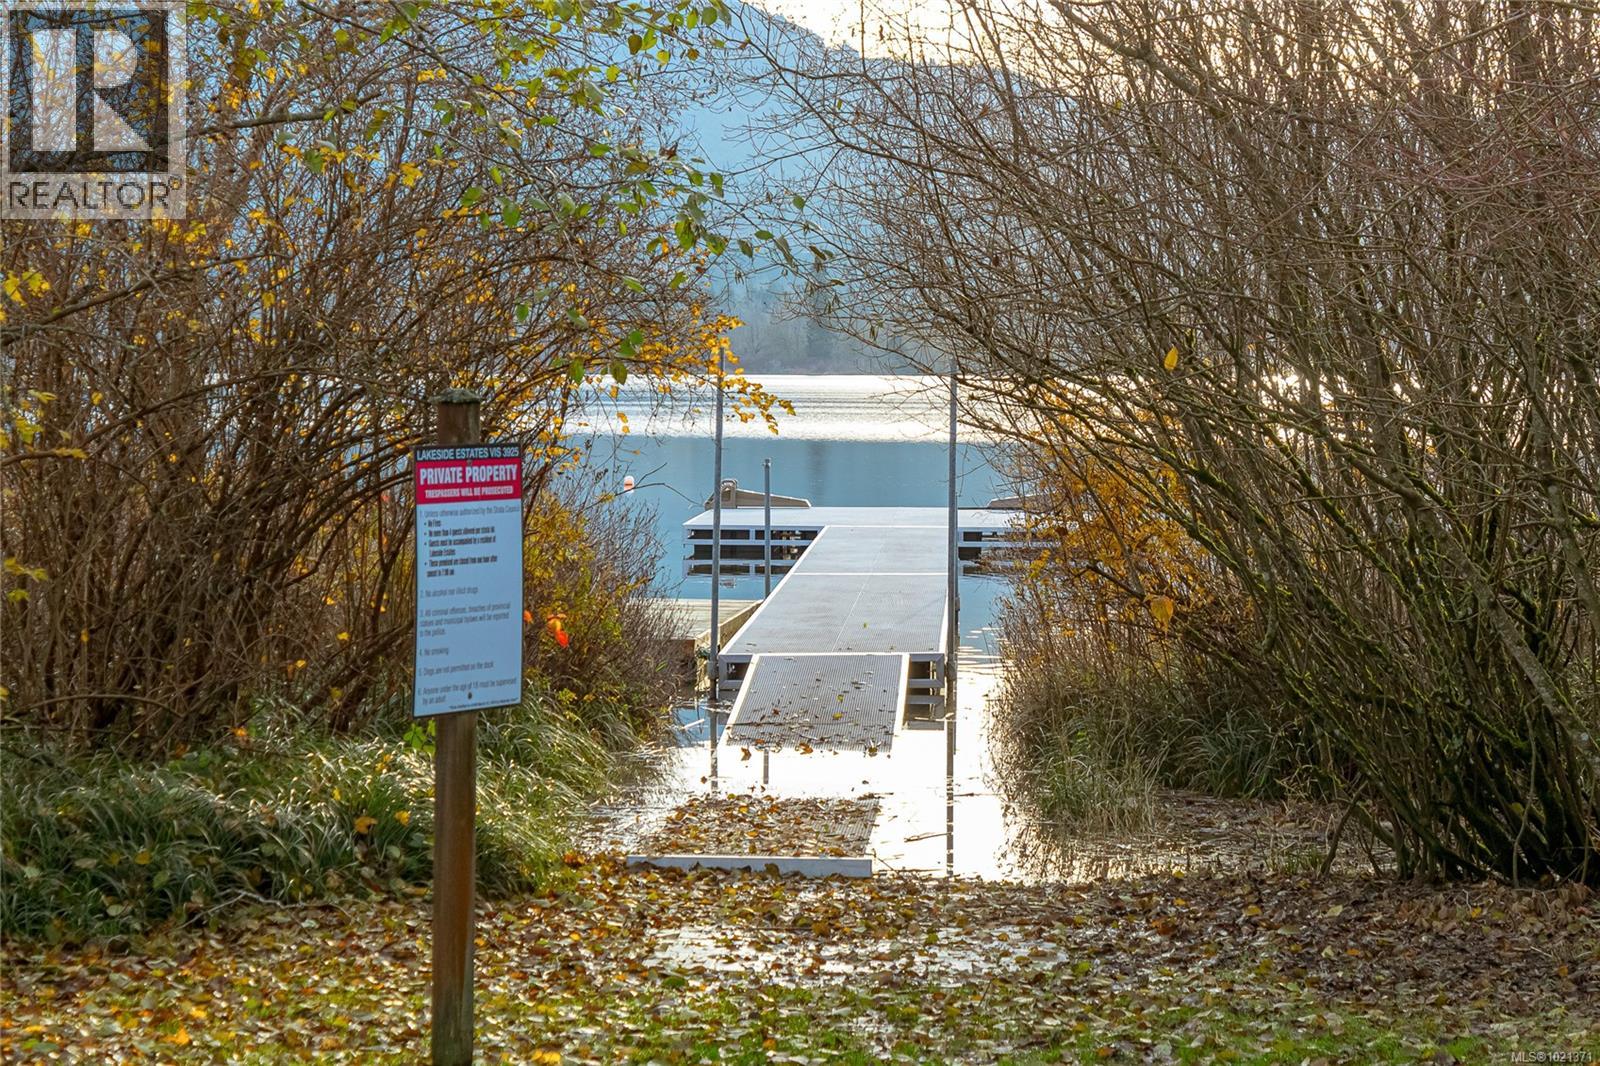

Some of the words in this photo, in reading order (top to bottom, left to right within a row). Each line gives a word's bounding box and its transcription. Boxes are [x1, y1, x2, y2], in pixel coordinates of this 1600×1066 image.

[417, 450, 455, 461] LAKESIDE
[456, 448, 488, 459] ESTATES
[489, 448, 501, 458] VIS
[503, 447, 519, 457] 3925
[420, 467, 462, 485] PRIVATE
[466, 465, 517, 483] PROPERTY
[461, 488, 473, 496] WILL
[474, 487, 480, 495] BE
